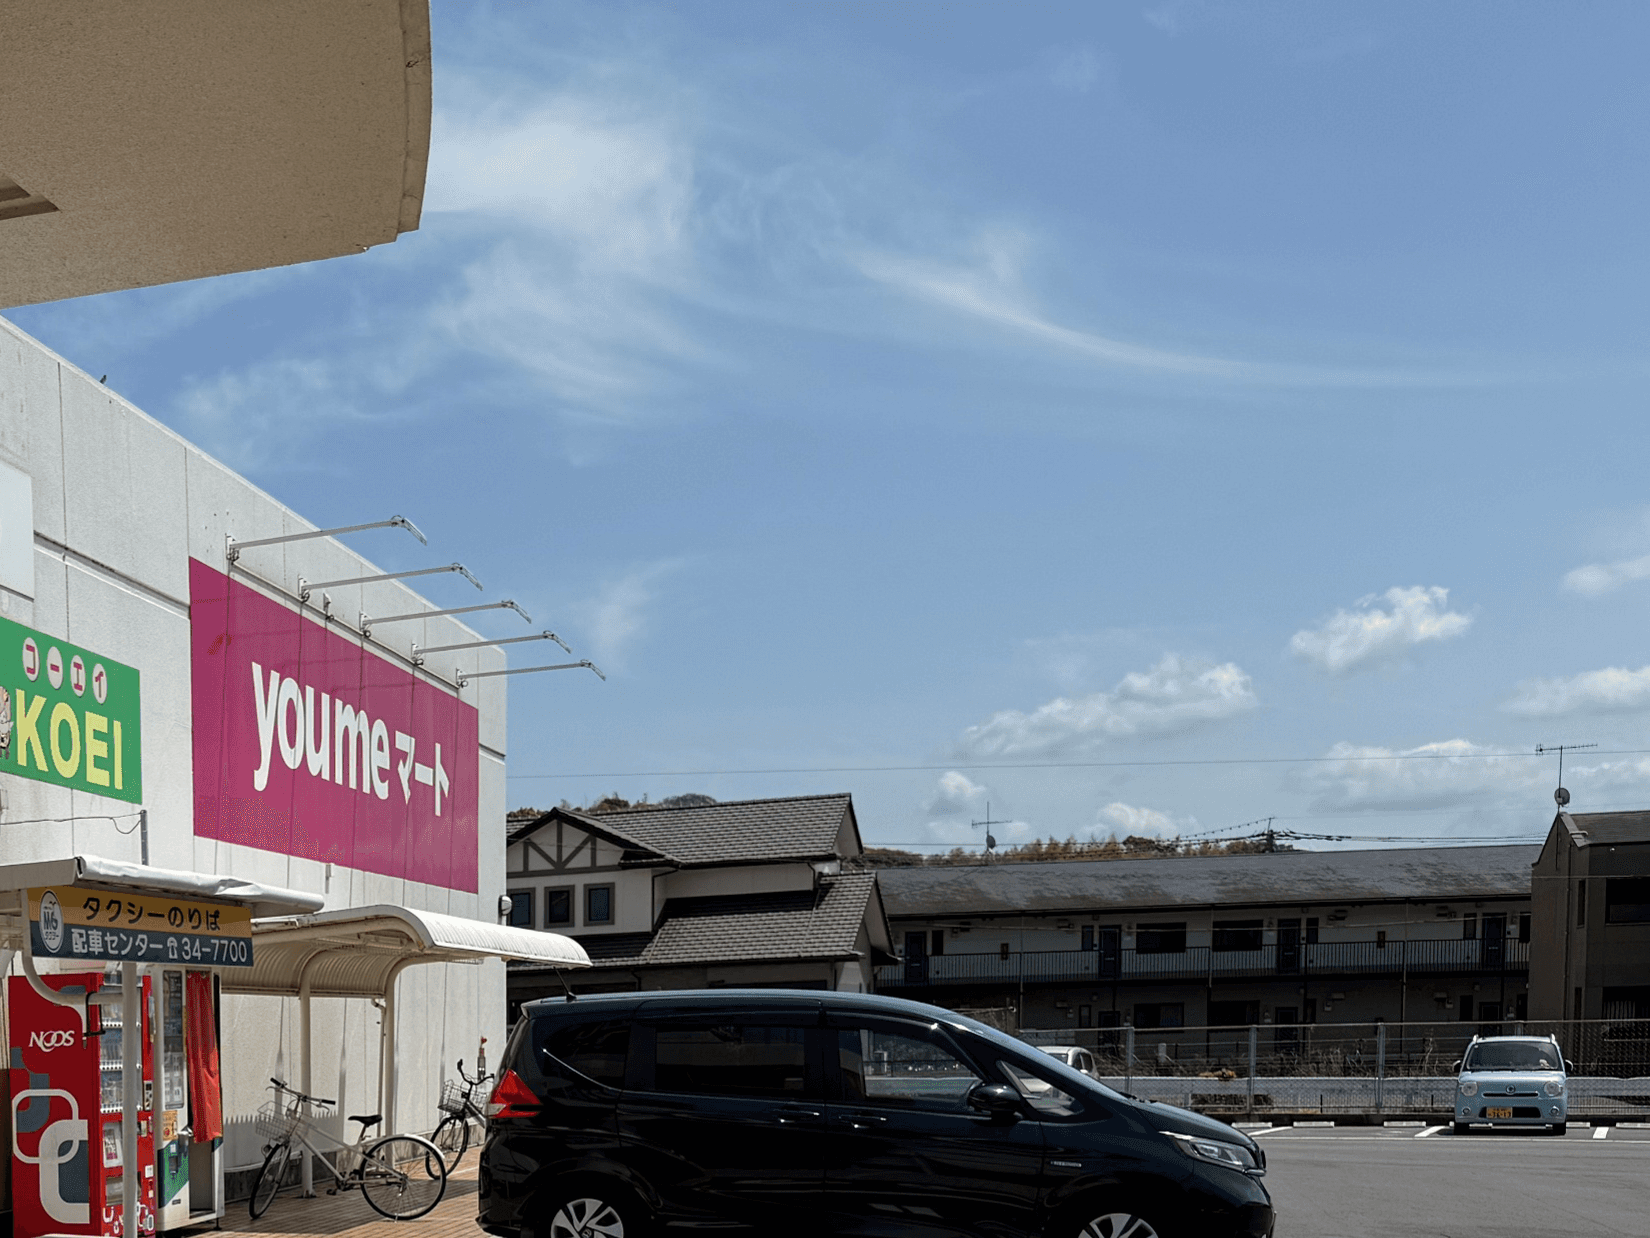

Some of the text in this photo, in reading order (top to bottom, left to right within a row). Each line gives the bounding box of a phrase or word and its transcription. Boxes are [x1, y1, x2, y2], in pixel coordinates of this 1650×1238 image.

[22, 636, 109, 704] コーエイ
[15, 687, 124, 791] KOEI
[251, 661, 451, 817] youme マート
[71, 928, 248, 963] 配車センター 34-7700
[83, 896, 221, 931] タクシーのりば
